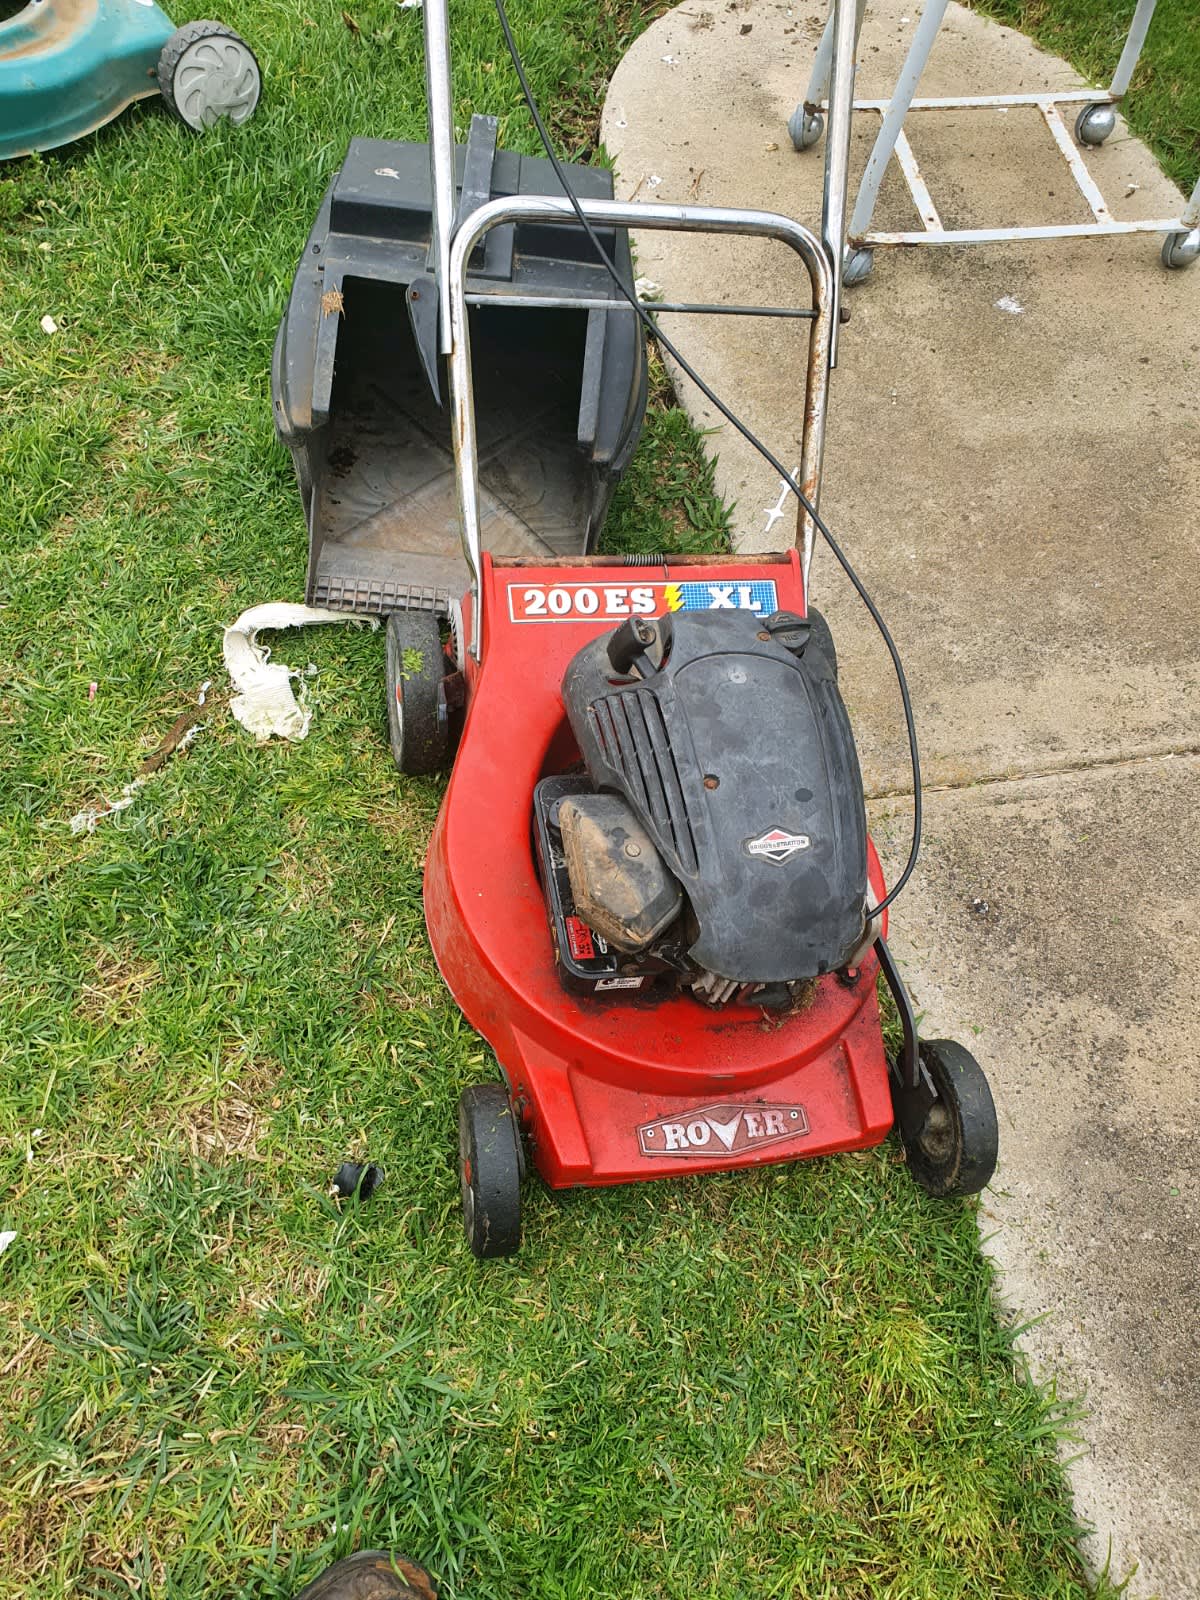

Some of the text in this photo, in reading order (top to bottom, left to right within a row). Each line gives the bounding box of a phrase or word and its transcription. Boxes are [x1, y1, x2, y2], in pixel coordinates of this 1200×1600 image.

[523, 586, 762, 615] 200 ES XL
[661, 1108, 788, 1151] ROVER
